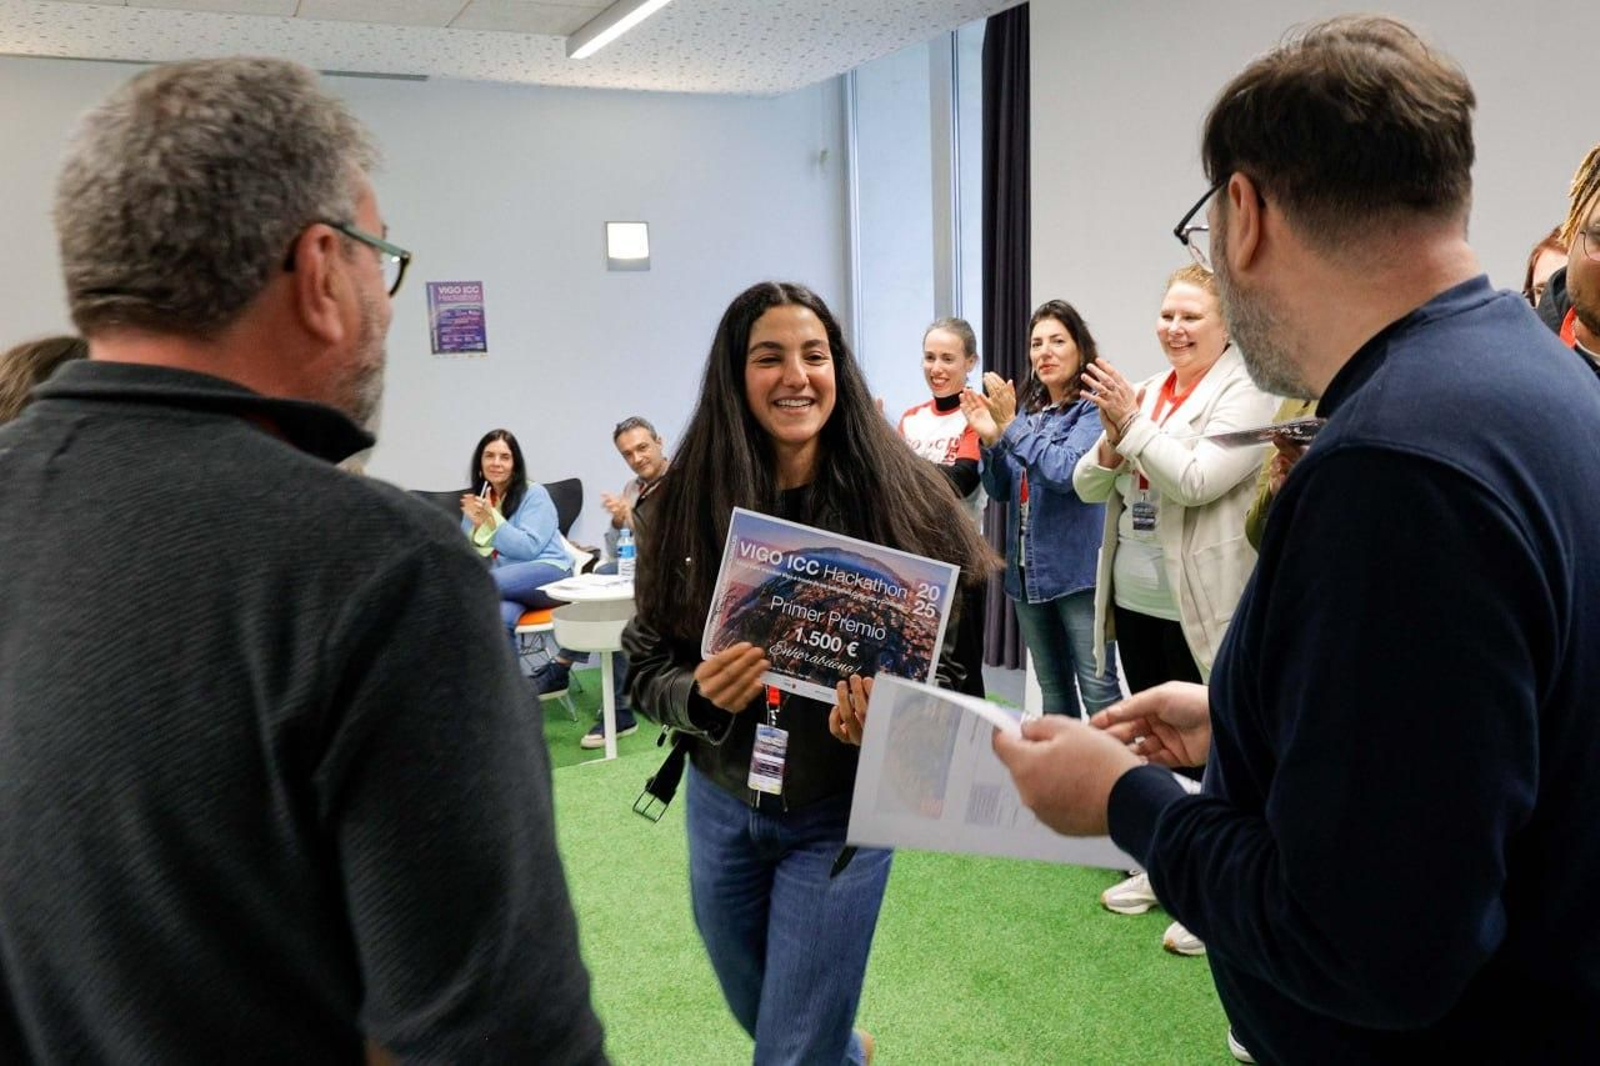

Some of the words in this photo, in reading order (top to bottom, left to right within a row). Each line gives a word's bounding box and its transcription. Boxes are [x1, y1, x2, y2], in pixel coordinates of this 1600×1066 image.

[438, 286, 461, 295] VIGO
[463, 286, 479, 294] ICC
[740, 541, 783, 565] VIGO
[787, 554, 820, 576] ICC
[823, 564, 908, 599] Hackathon
[915, 583, 940, 601] 20
[770, 595, 825, 622] Primer
[829, 611, 886, 640] Premio
[912, 600, 937, 618] 25
[795, 627, 841, 652] 1.500
[847, 641, 859, 657] €
